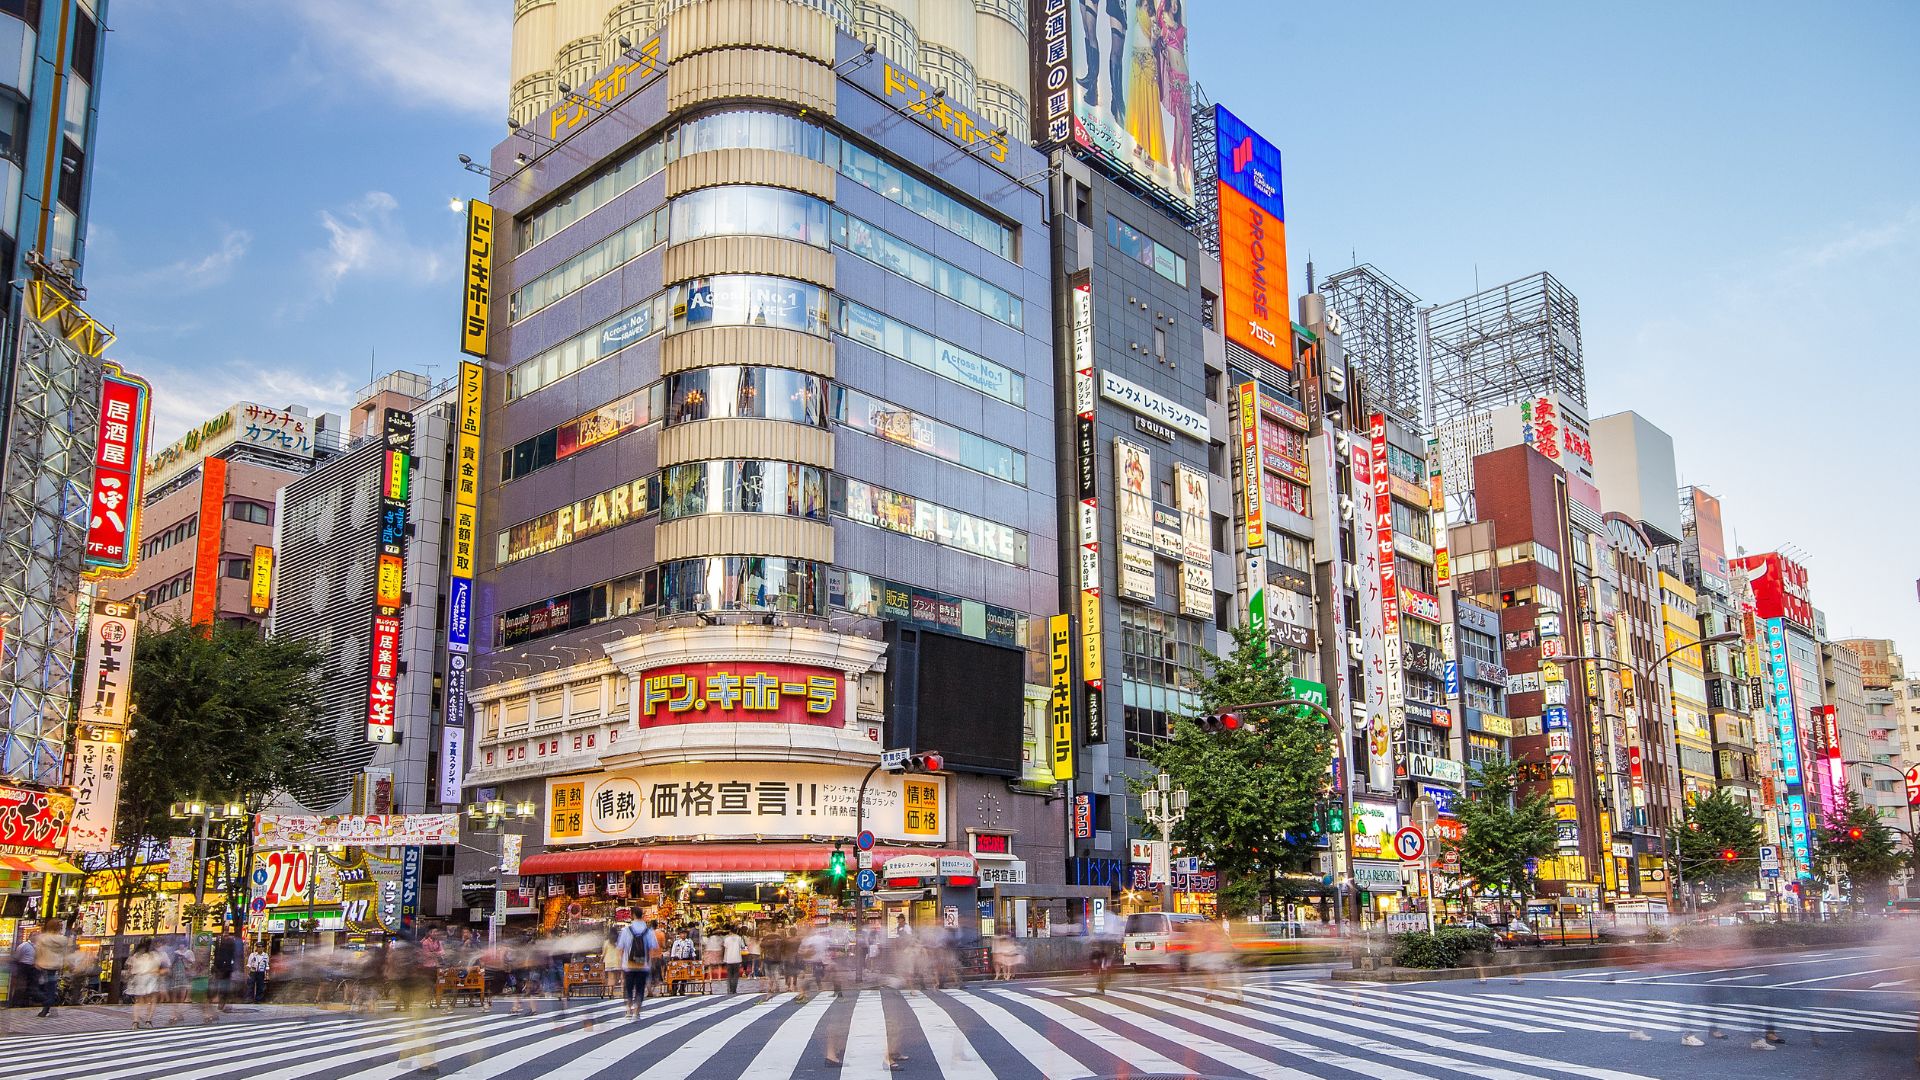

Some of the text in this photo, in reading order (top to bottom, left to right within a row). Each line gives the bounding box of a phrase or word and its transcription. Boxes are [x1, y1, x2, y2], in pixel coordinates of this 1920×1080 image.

[1249, 207, 1269, 321] PROMISE
[1249, 320, 1276, 348] プロミス
[465, 369, 479, 432] ブランド品
[1107, 379, 1208, 431] エンタメレストランタワー
[1307, 384, 1318, 423] 水上ビル
[103, 399, 130, 465] 居酒屋
[246, 405, 304, 433] サウナ&
[1140, 418, 1176, 440] SQUARE
[244, 423, 313, 451] カプセル
[461, 446, 475, 494] 貴金属
[90, 477, 125, 532] つぼ八
[556, 477, 647, 540] FLARE
[1370, 424, 1395, 580] カラオケパセラ
[915, 500, 1014, 553] FLARE
[456, 513, 471, 570] 高額買取
[508, 547, 536, 563] PHOTO
[1184, 546, 1211, 562] Carnival
[104, 604, 129, 616] 6F
[382, 607, 395, 616] 6F
[886, 590, 909, 609] 販売
[913, 599, 936, 611] ブランド
[1362, 491, 1385, 706] カラオケパセラ
[376, 635, 393, 678] 居楽屋
[1387, 638, 1400, 691] パーティー
[1446, 661, 1457, 694] 747
[90, 729, 115, 741] 5F
[1392, 730, 1405, 764] ダーツ
[555, 787, 581, 807] 情熱
[596, 789, 636, 820] 情熱
[649, 780, 817, 819] 価格宣言!!
[907, 785, 936, 804] 情熱
[554, 812, 581, 833] 価格
[907, 810, 936, 829] 価格
[16, 846, 33, 856] YAKI
[1762, 848, 1772, 860] P
[338, 869, 365, 880] カラオケ
[404, 849, 419, 903] カラオケ
[862, 876, 870, 887] P
[983, 868, 1024, 883] 価格宣言!!
[341, 900, 370, 922] 747
[384, 880, 397, 927] カラオケ
[402, 906, 415, 914] B1
